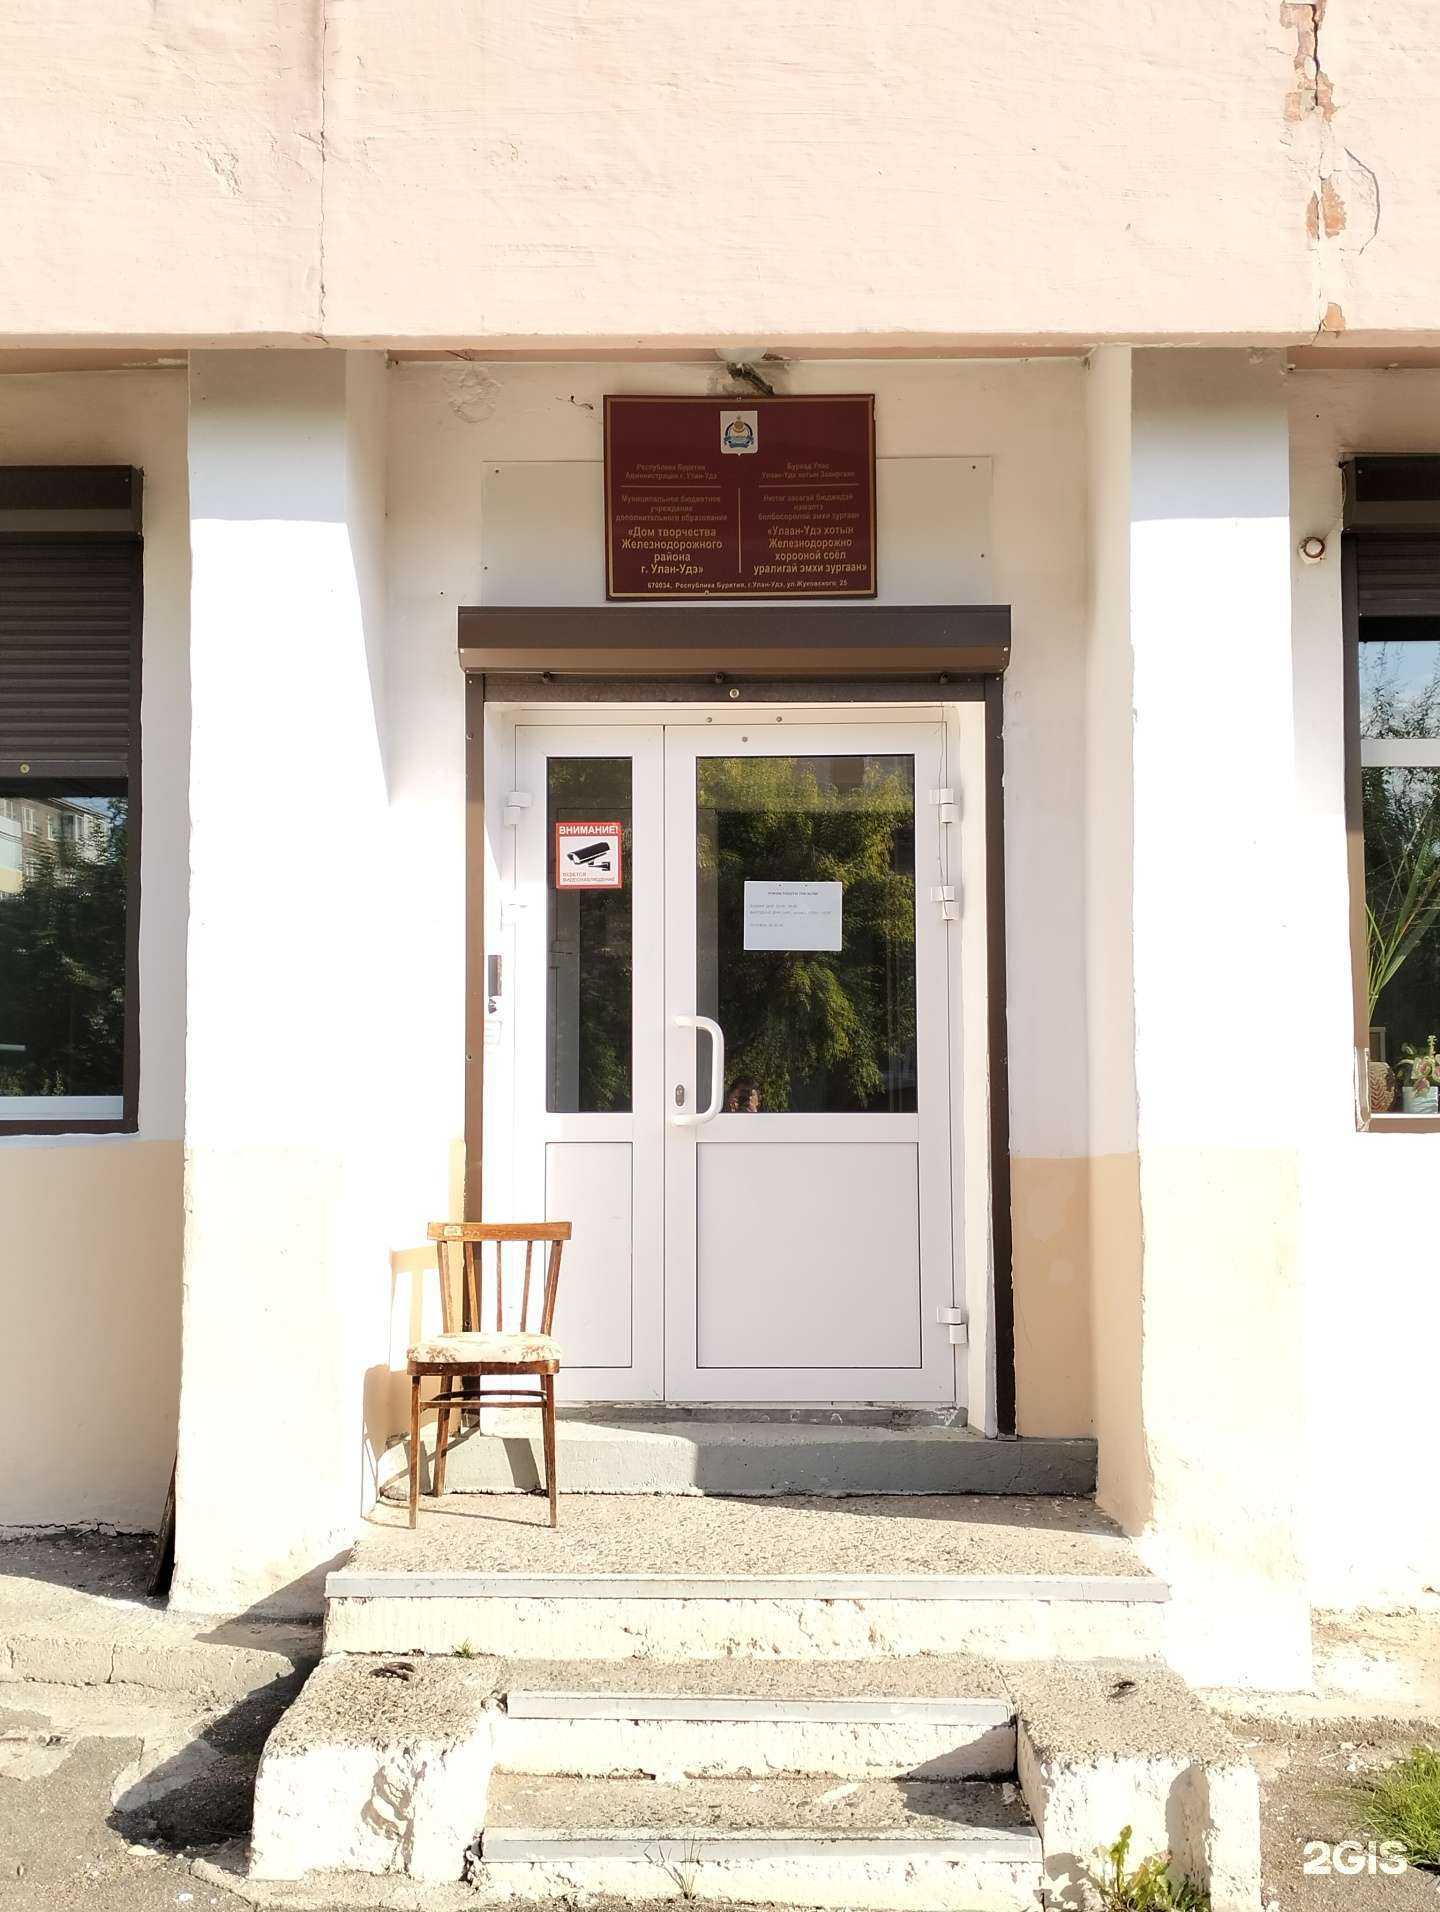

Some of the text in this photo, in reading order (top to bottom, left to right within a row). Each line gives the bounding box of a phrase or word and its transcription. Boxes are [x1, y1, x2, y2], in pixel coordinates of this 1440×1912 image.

[628, 527, 717, 538] «Дом творчества
[824, 526, 854, 536] хотын
[622, 539, 723, 551] Железнодорожного
[768, 538, 853, 549] Железнодорожно
[654, 552, 691, 563] района
[775, 550, 822, 562] хорооной
[651, 564, 704, 575] Улан-Удэ»
[753, 563, 867, 575] уралигай эмхи зургаан»
[559, 825, 619, 835] ВНИМАНИЕ!
